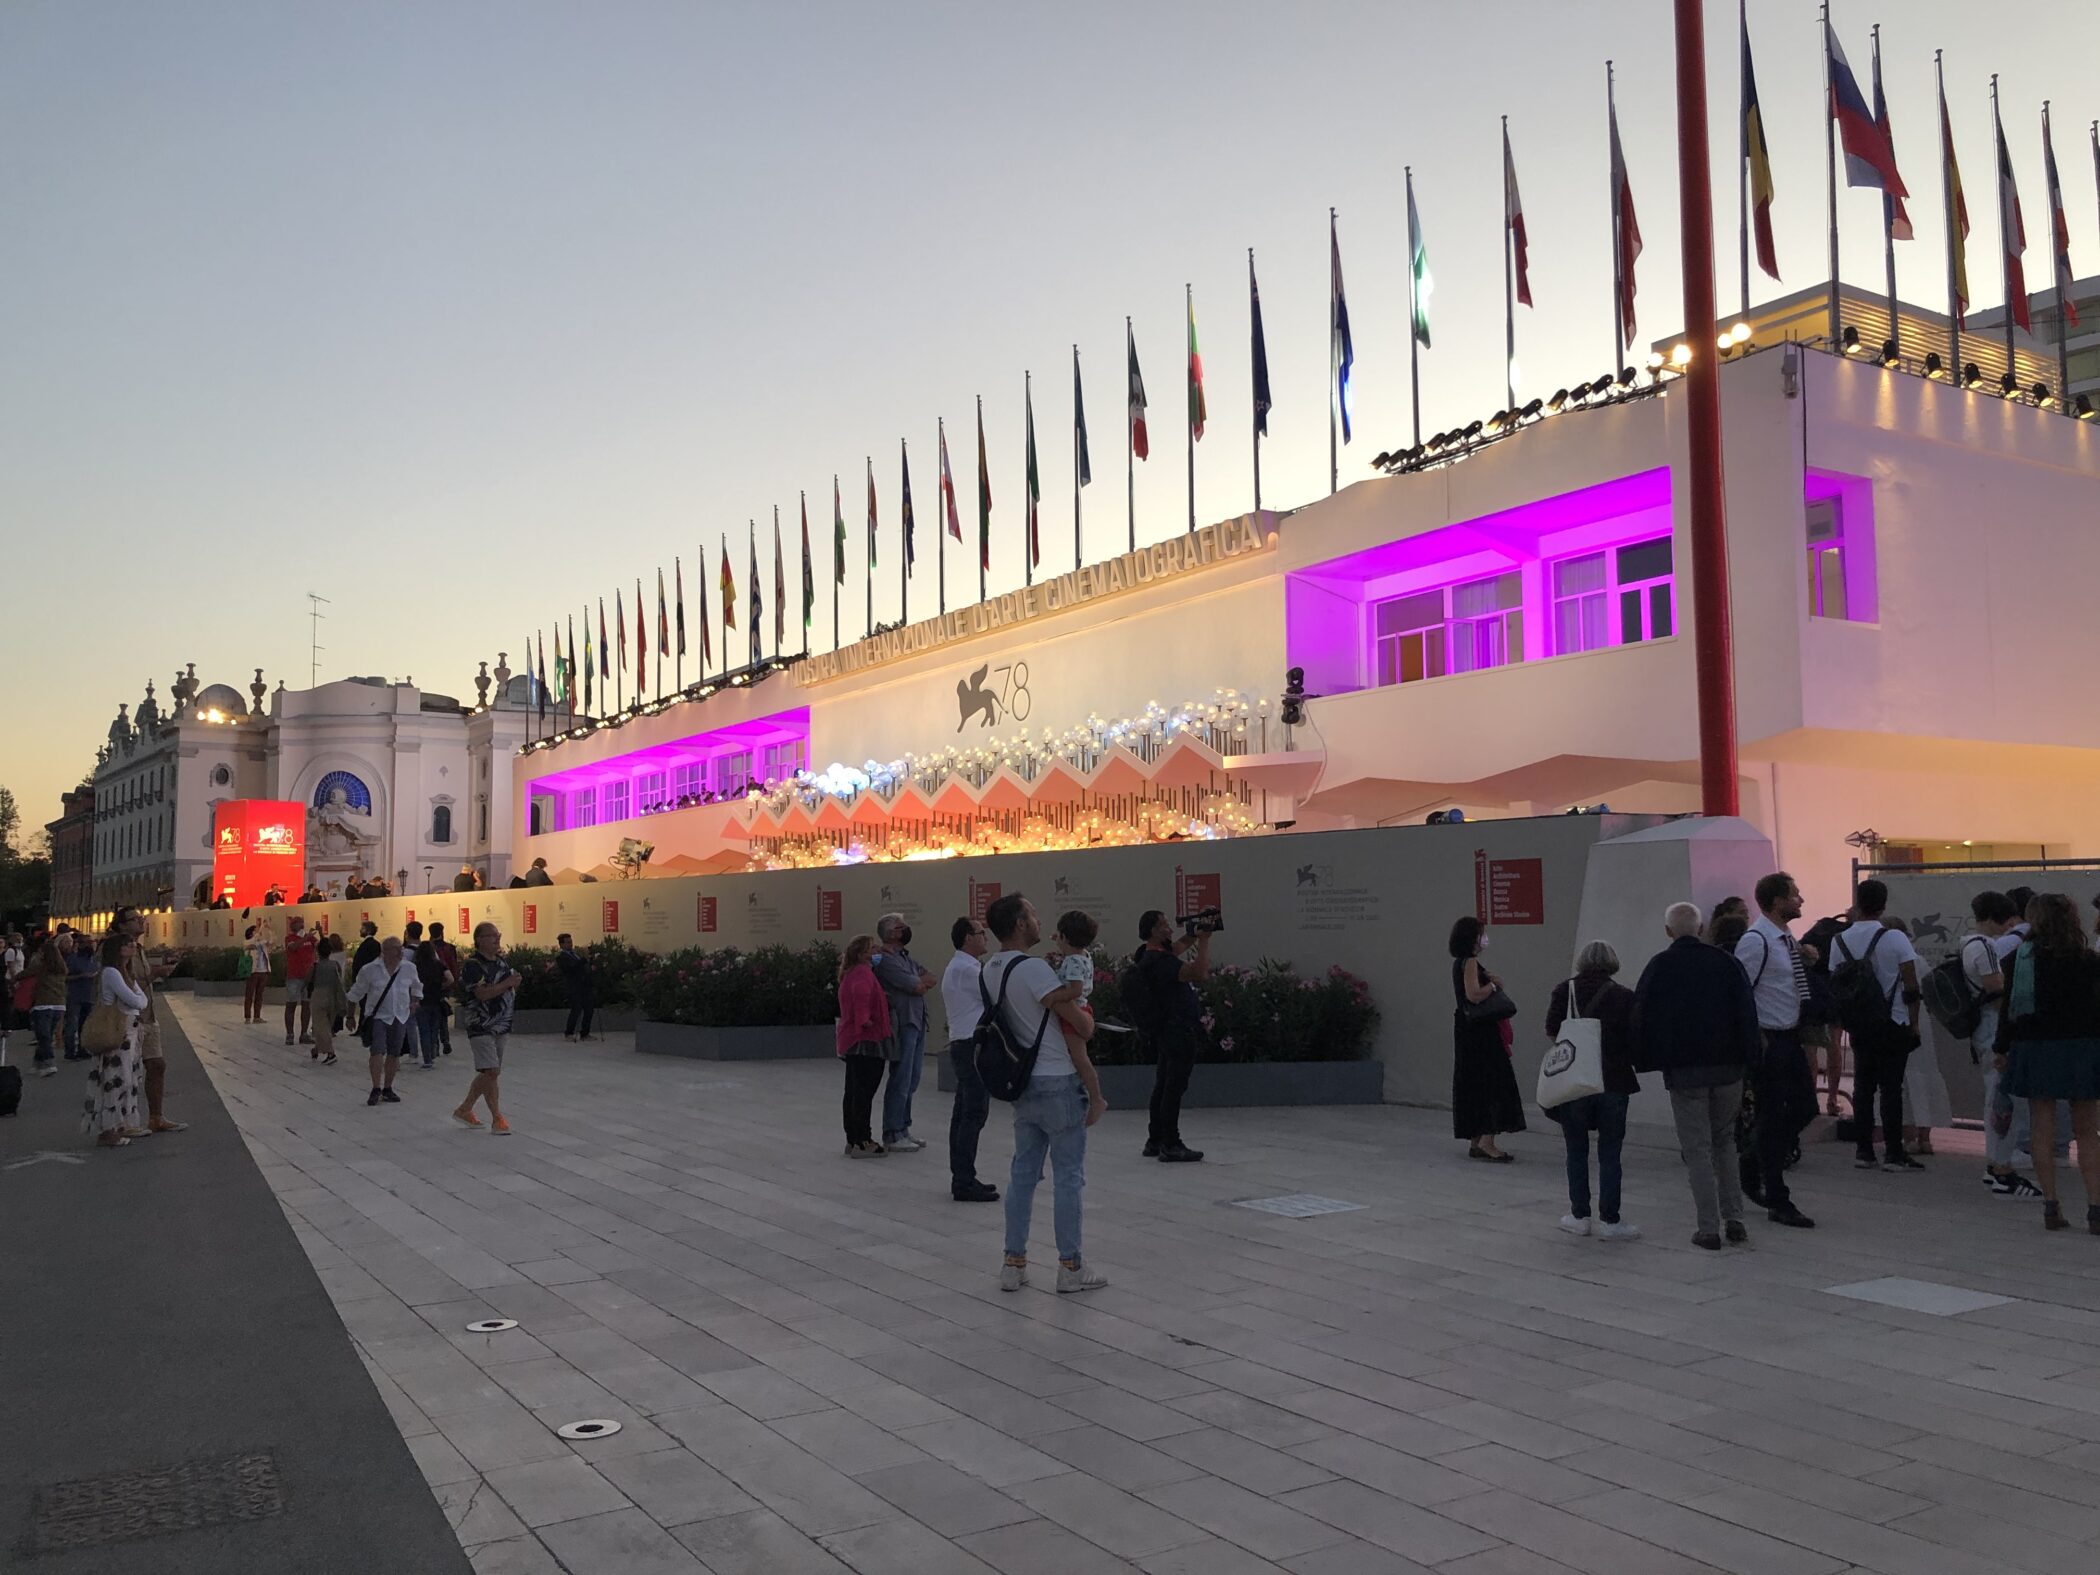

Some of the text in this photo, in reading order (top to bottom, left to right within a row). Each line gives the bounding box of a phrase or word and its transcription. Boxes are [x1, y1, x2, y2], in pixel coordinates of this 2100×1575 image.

[789, 514, 1263, 688] MOSTRA INTERNAZIONALE D'ARTE CINEMATOGRAFICA
[994, 662, 1031, 726] 78
[231, 828, 241, 843] 78
[279, 828, 294, 844] 78
